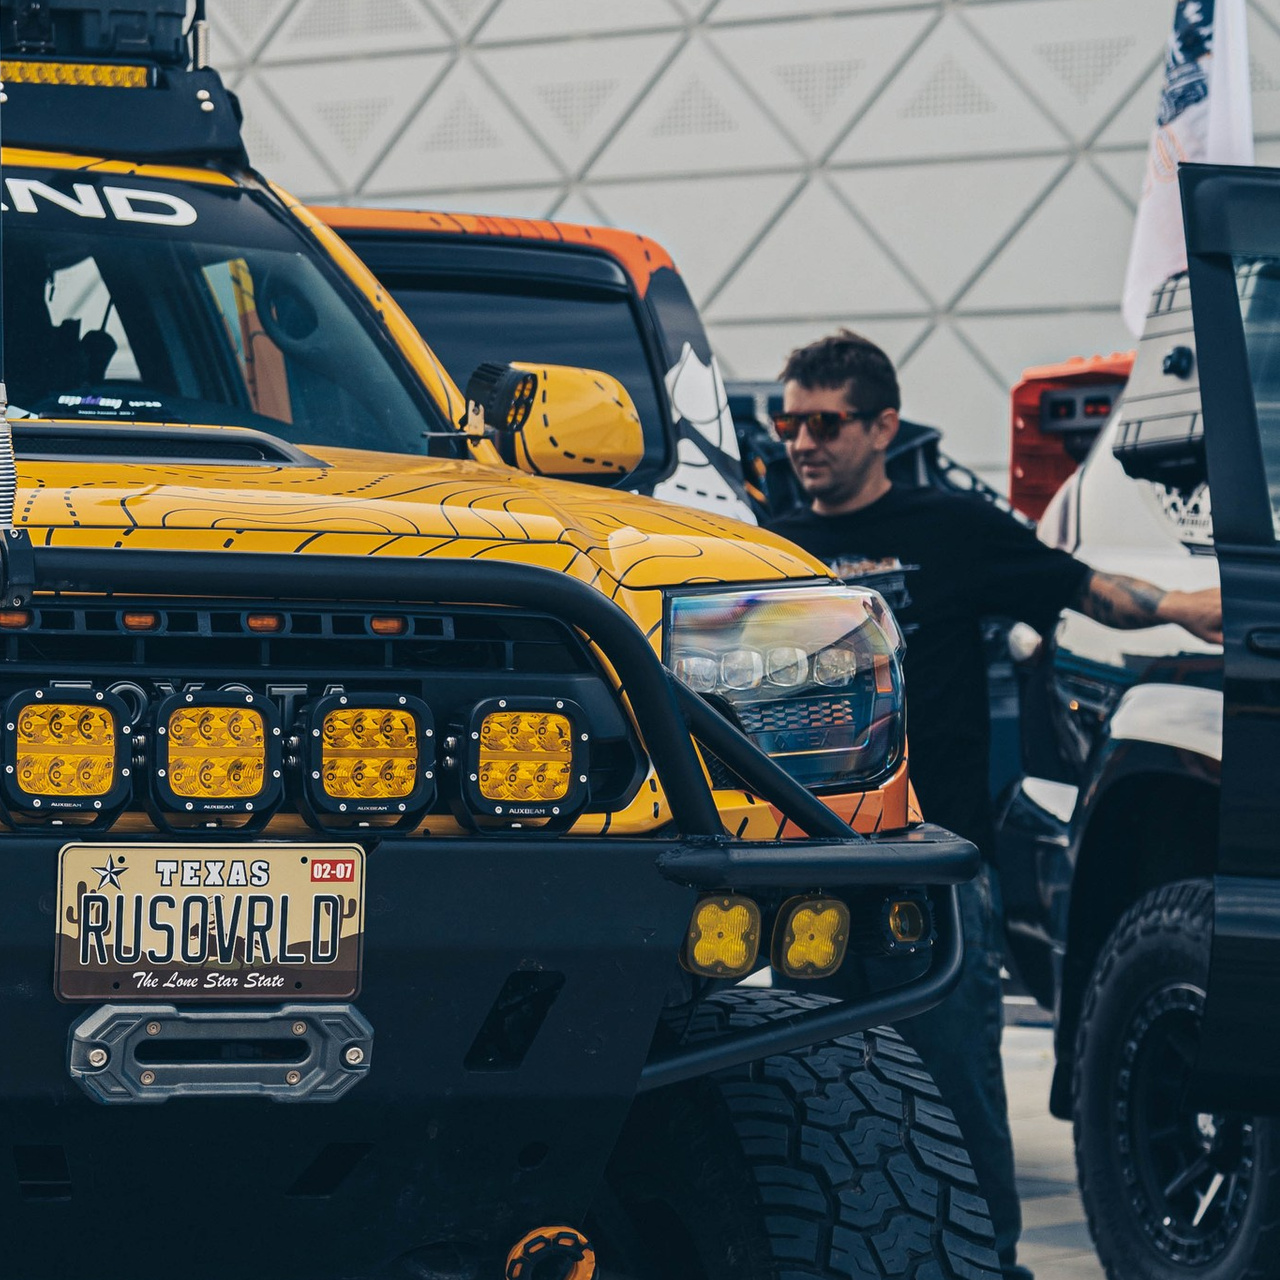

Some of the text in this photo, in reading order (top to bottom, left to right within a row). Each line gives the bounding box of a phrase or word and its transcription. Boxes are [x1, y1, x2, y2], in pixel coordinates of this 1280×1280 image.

[508, 807, 546, 815] AUXBEAM
[155, 859, 270, 887] TEXAS
[313, 863, 353, 879] 02-07
[79, 893, 341, 965] RUSOVRLD
[132, 971, 285, 989] The Lone Star State
